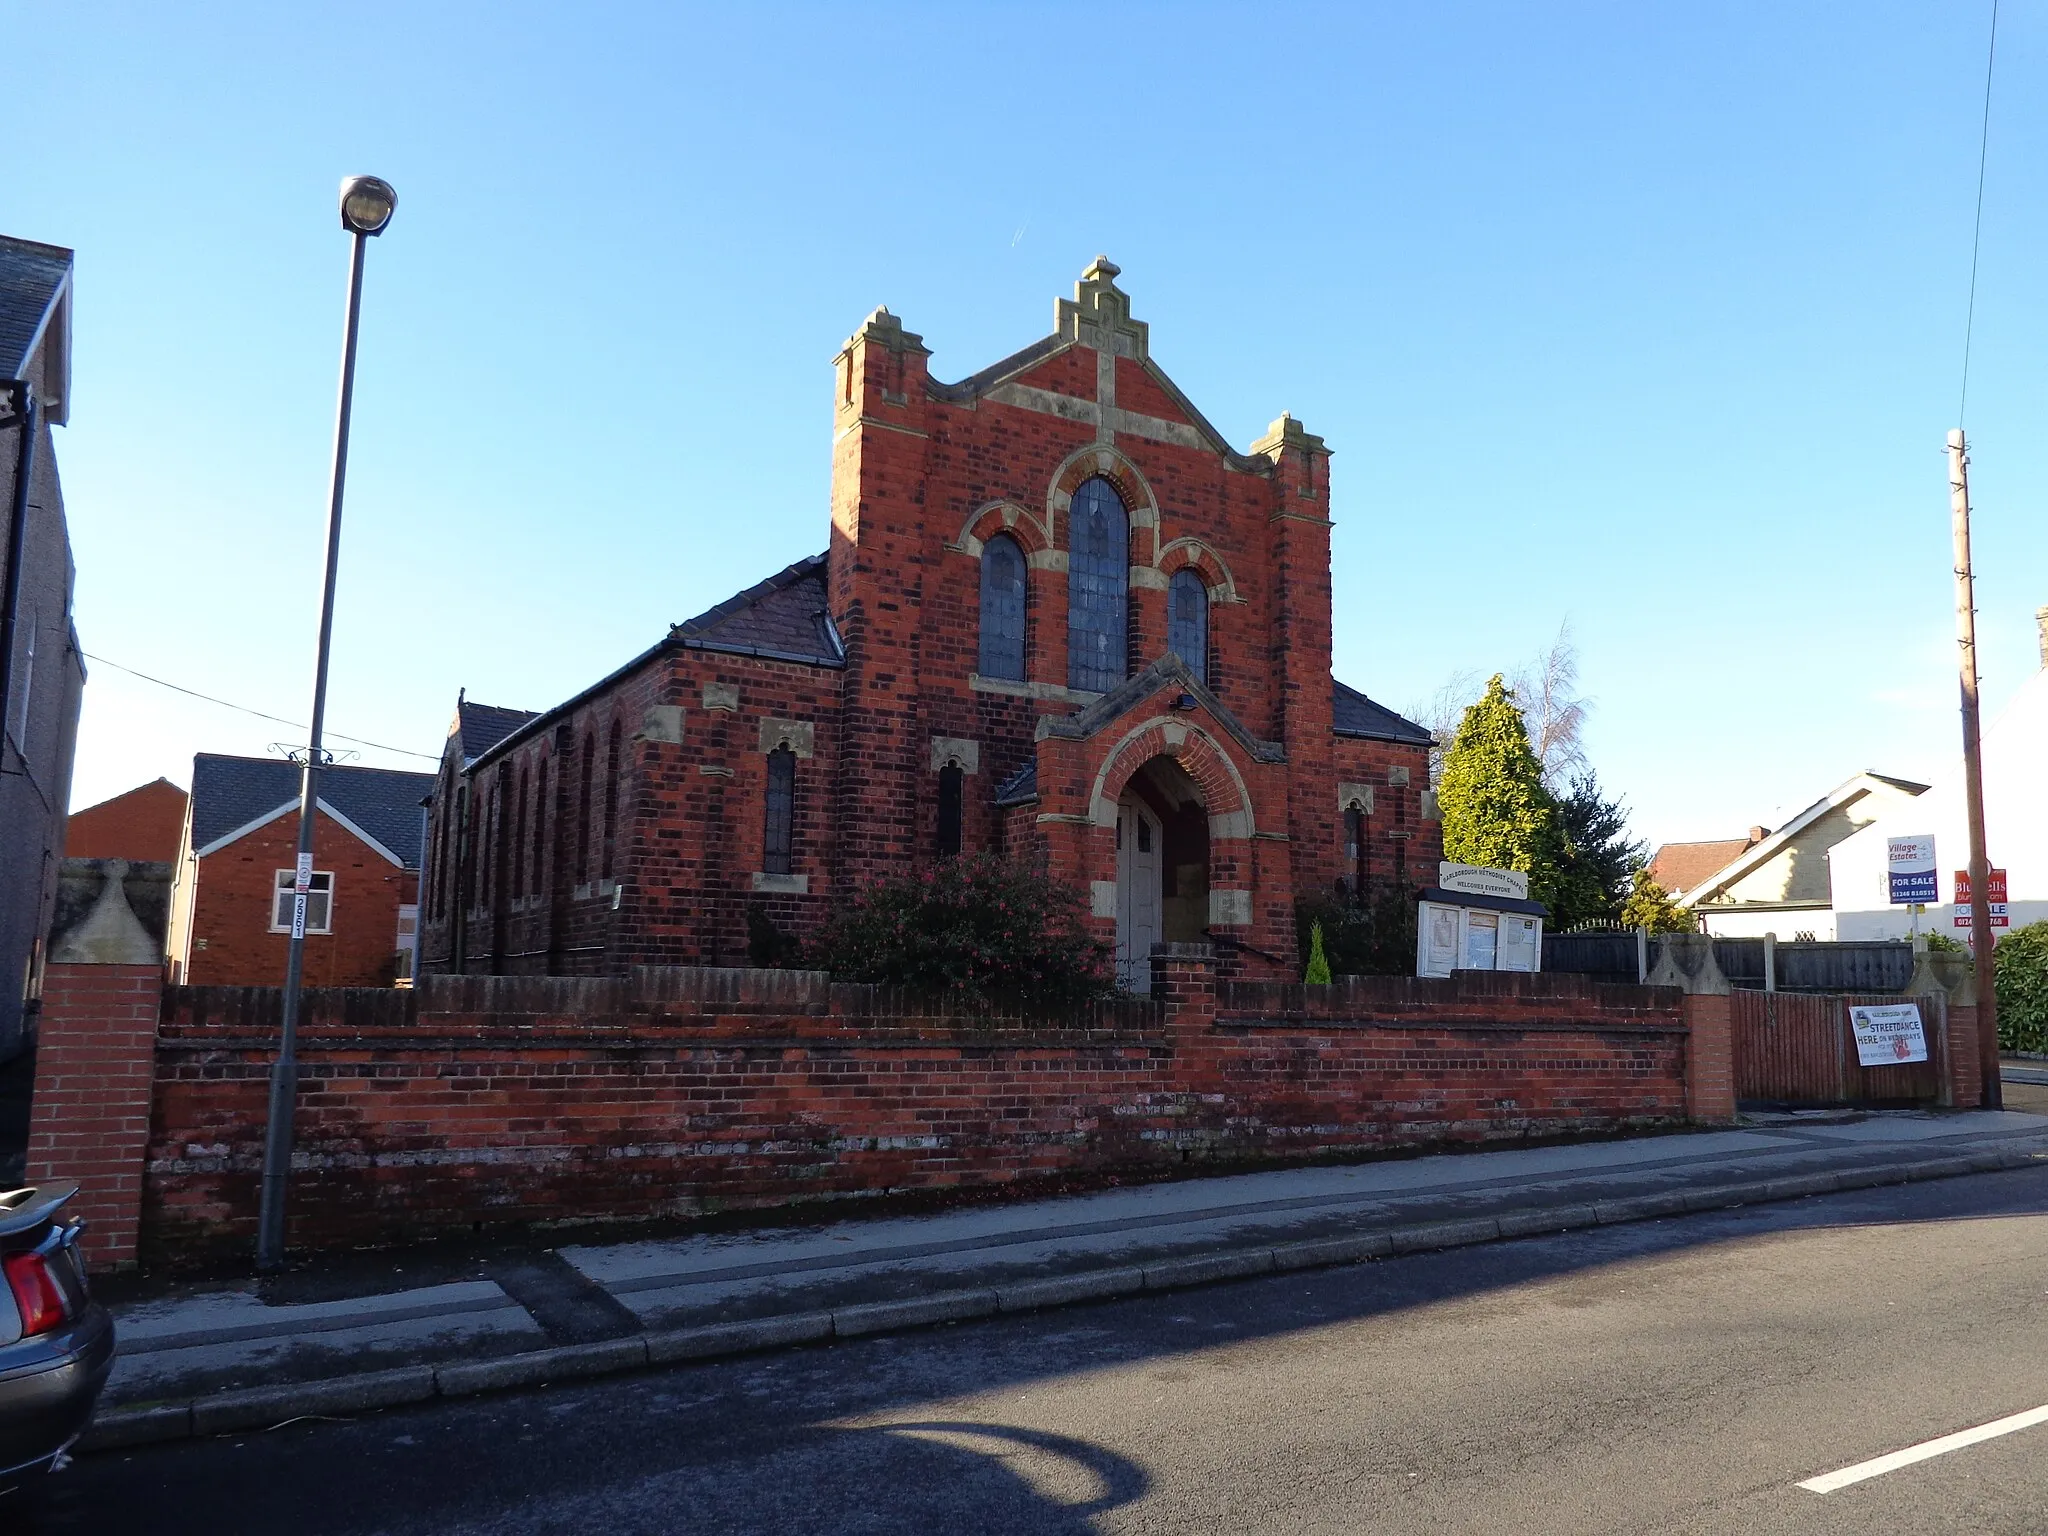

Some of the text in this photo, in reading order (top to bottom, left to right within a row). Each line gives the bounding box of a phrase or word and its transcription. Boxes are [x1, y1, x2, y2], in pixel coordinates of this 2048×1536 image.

[1889, 844, 1917, 852] Village
[1479, 869, 1506, 881] METHODIST
[1507, 877, 1524, 894] CHAPEL
[1892, 876, 1935, 886] FOR SALE
[1457, 881, 1511, 893] WELCOMES EVERYONE
[296, 898, 304, 937] 2961
[1870, 1021, 1920, 1032] STREETDANCE
[1857, 1035, 1879, 1045] HERE
